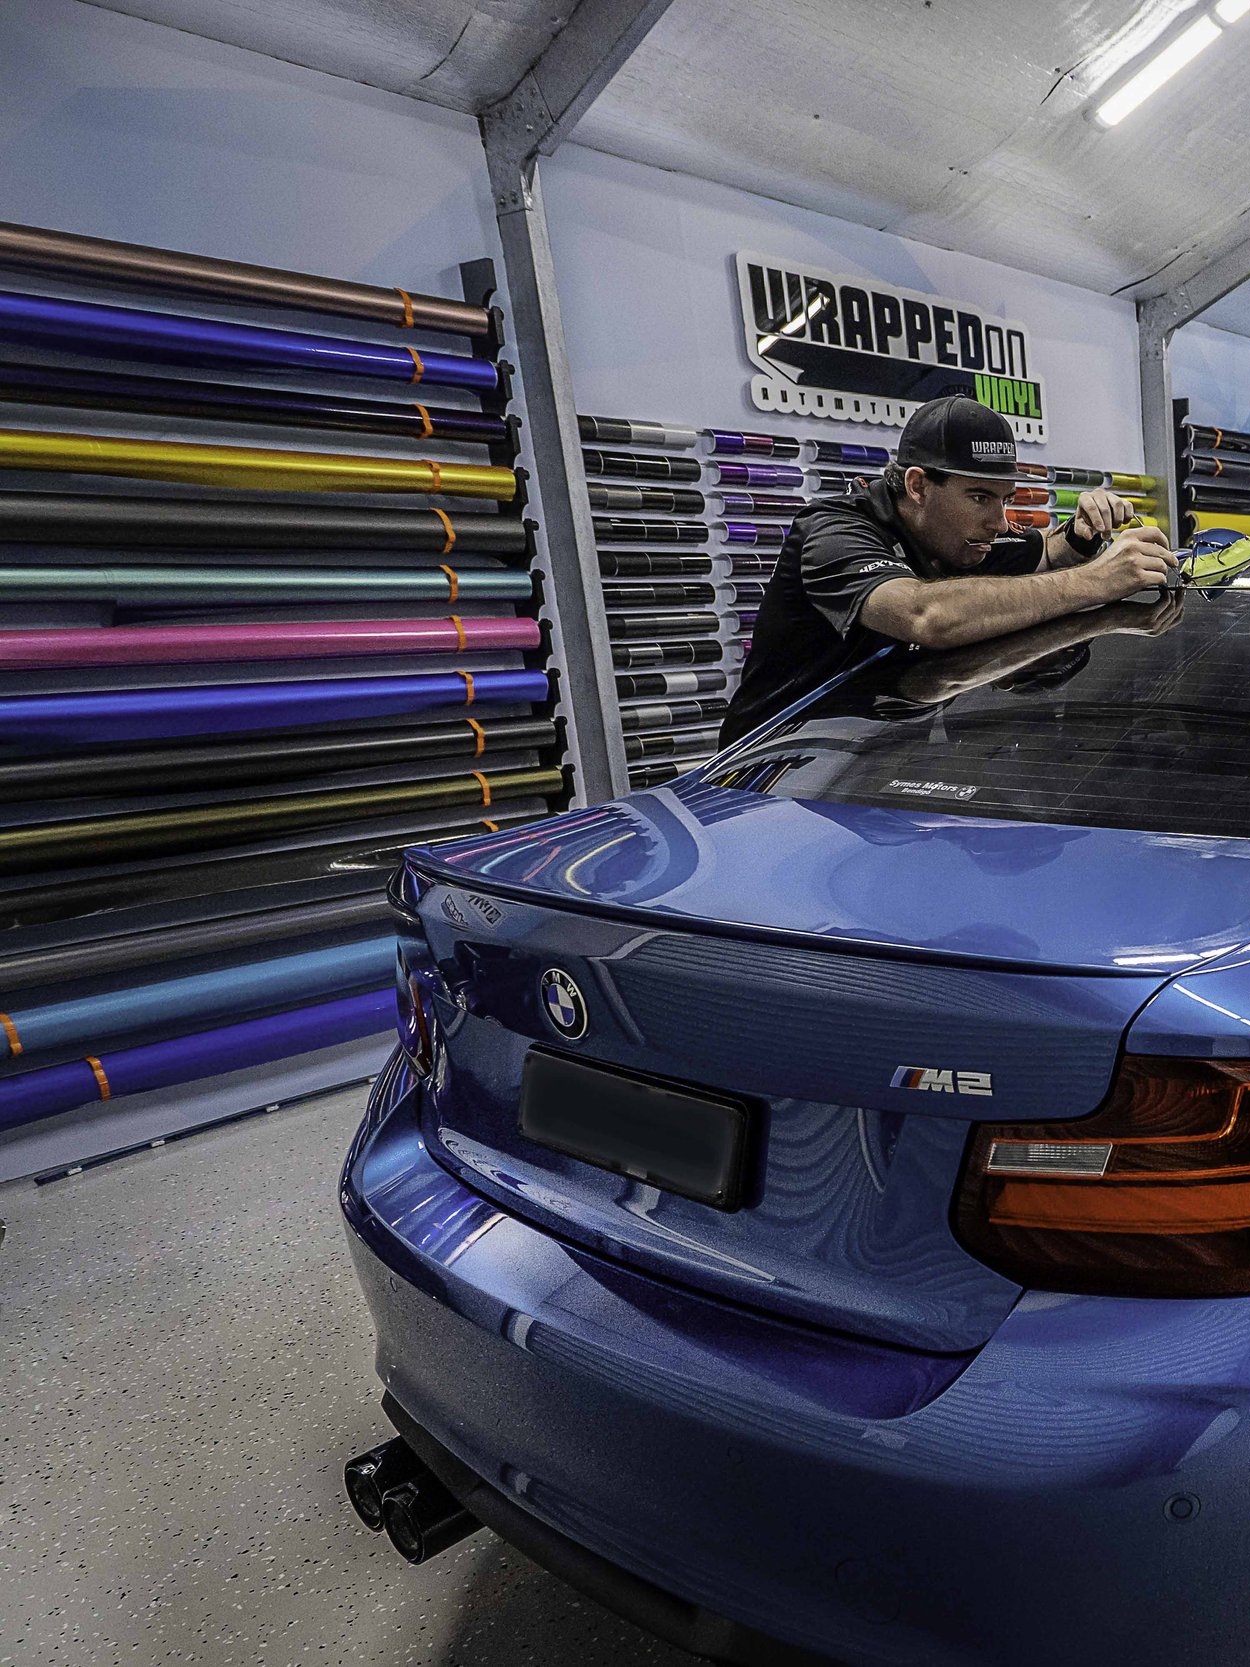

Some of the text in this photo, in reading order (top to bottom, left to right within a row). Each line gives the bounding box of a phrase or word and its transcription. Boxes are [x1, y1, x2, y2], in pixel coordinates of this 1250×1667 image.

[975, 373, 1041, 418] VINYL
[922, 781, 958, 792] Motors
[917, 1068, 993, 1096] M2
